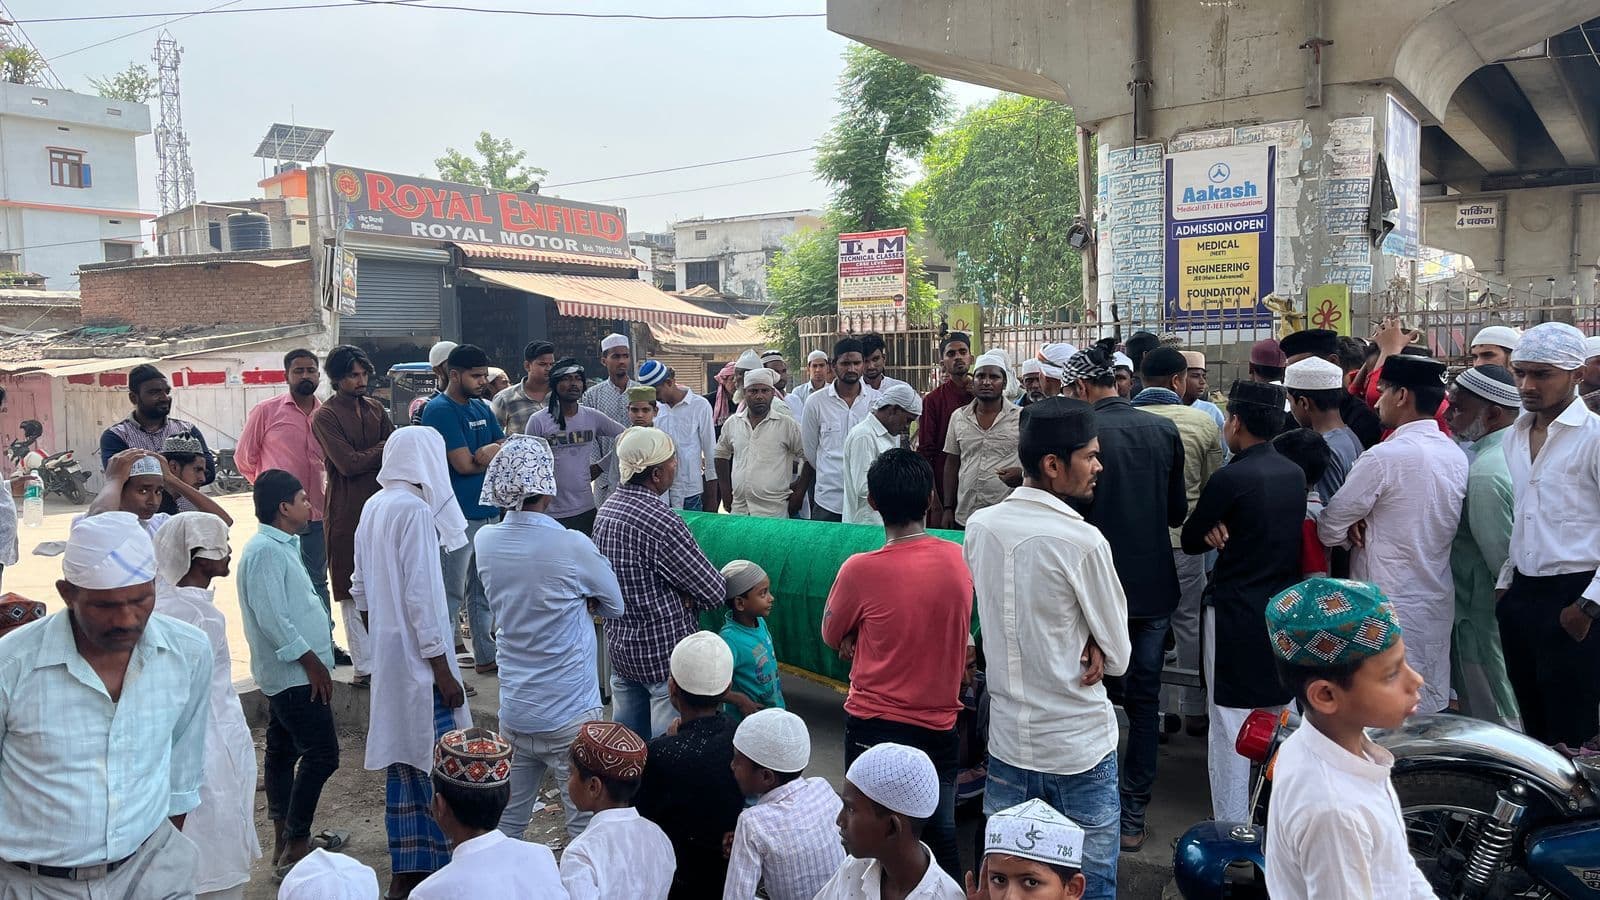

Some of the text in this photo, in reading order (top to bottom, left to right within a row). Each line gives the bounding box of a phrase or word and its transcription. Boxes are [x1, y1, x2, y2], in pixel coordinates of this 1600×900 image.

[1183, 181, 1257, 203] Aakash
[1346, 183, 1369, 192] BPSC
[365, 172, 624, 242] ROYAL ENFIELD
[1460, 205, 1492, 216] पार्किंग
[1176, 219, 1264, 236] ADMISSION OPEN
[1457, 218, 1464, 227] 4
[410, 222, 493, 243] ROYAL
[500, 231, 580, 252] MOTOR
[1197, 240, 1239, 251] MEDICAL
[841, 252, 904, 262] TECHNICAL CLASSES
[1186, 262, 1250, 275] ENGINEERING
[1349, 270, 1370, 279] BPSC
[1187, 286, 1250, 298] FOUNDATION
[1057, 844, 1072, 857] 786
